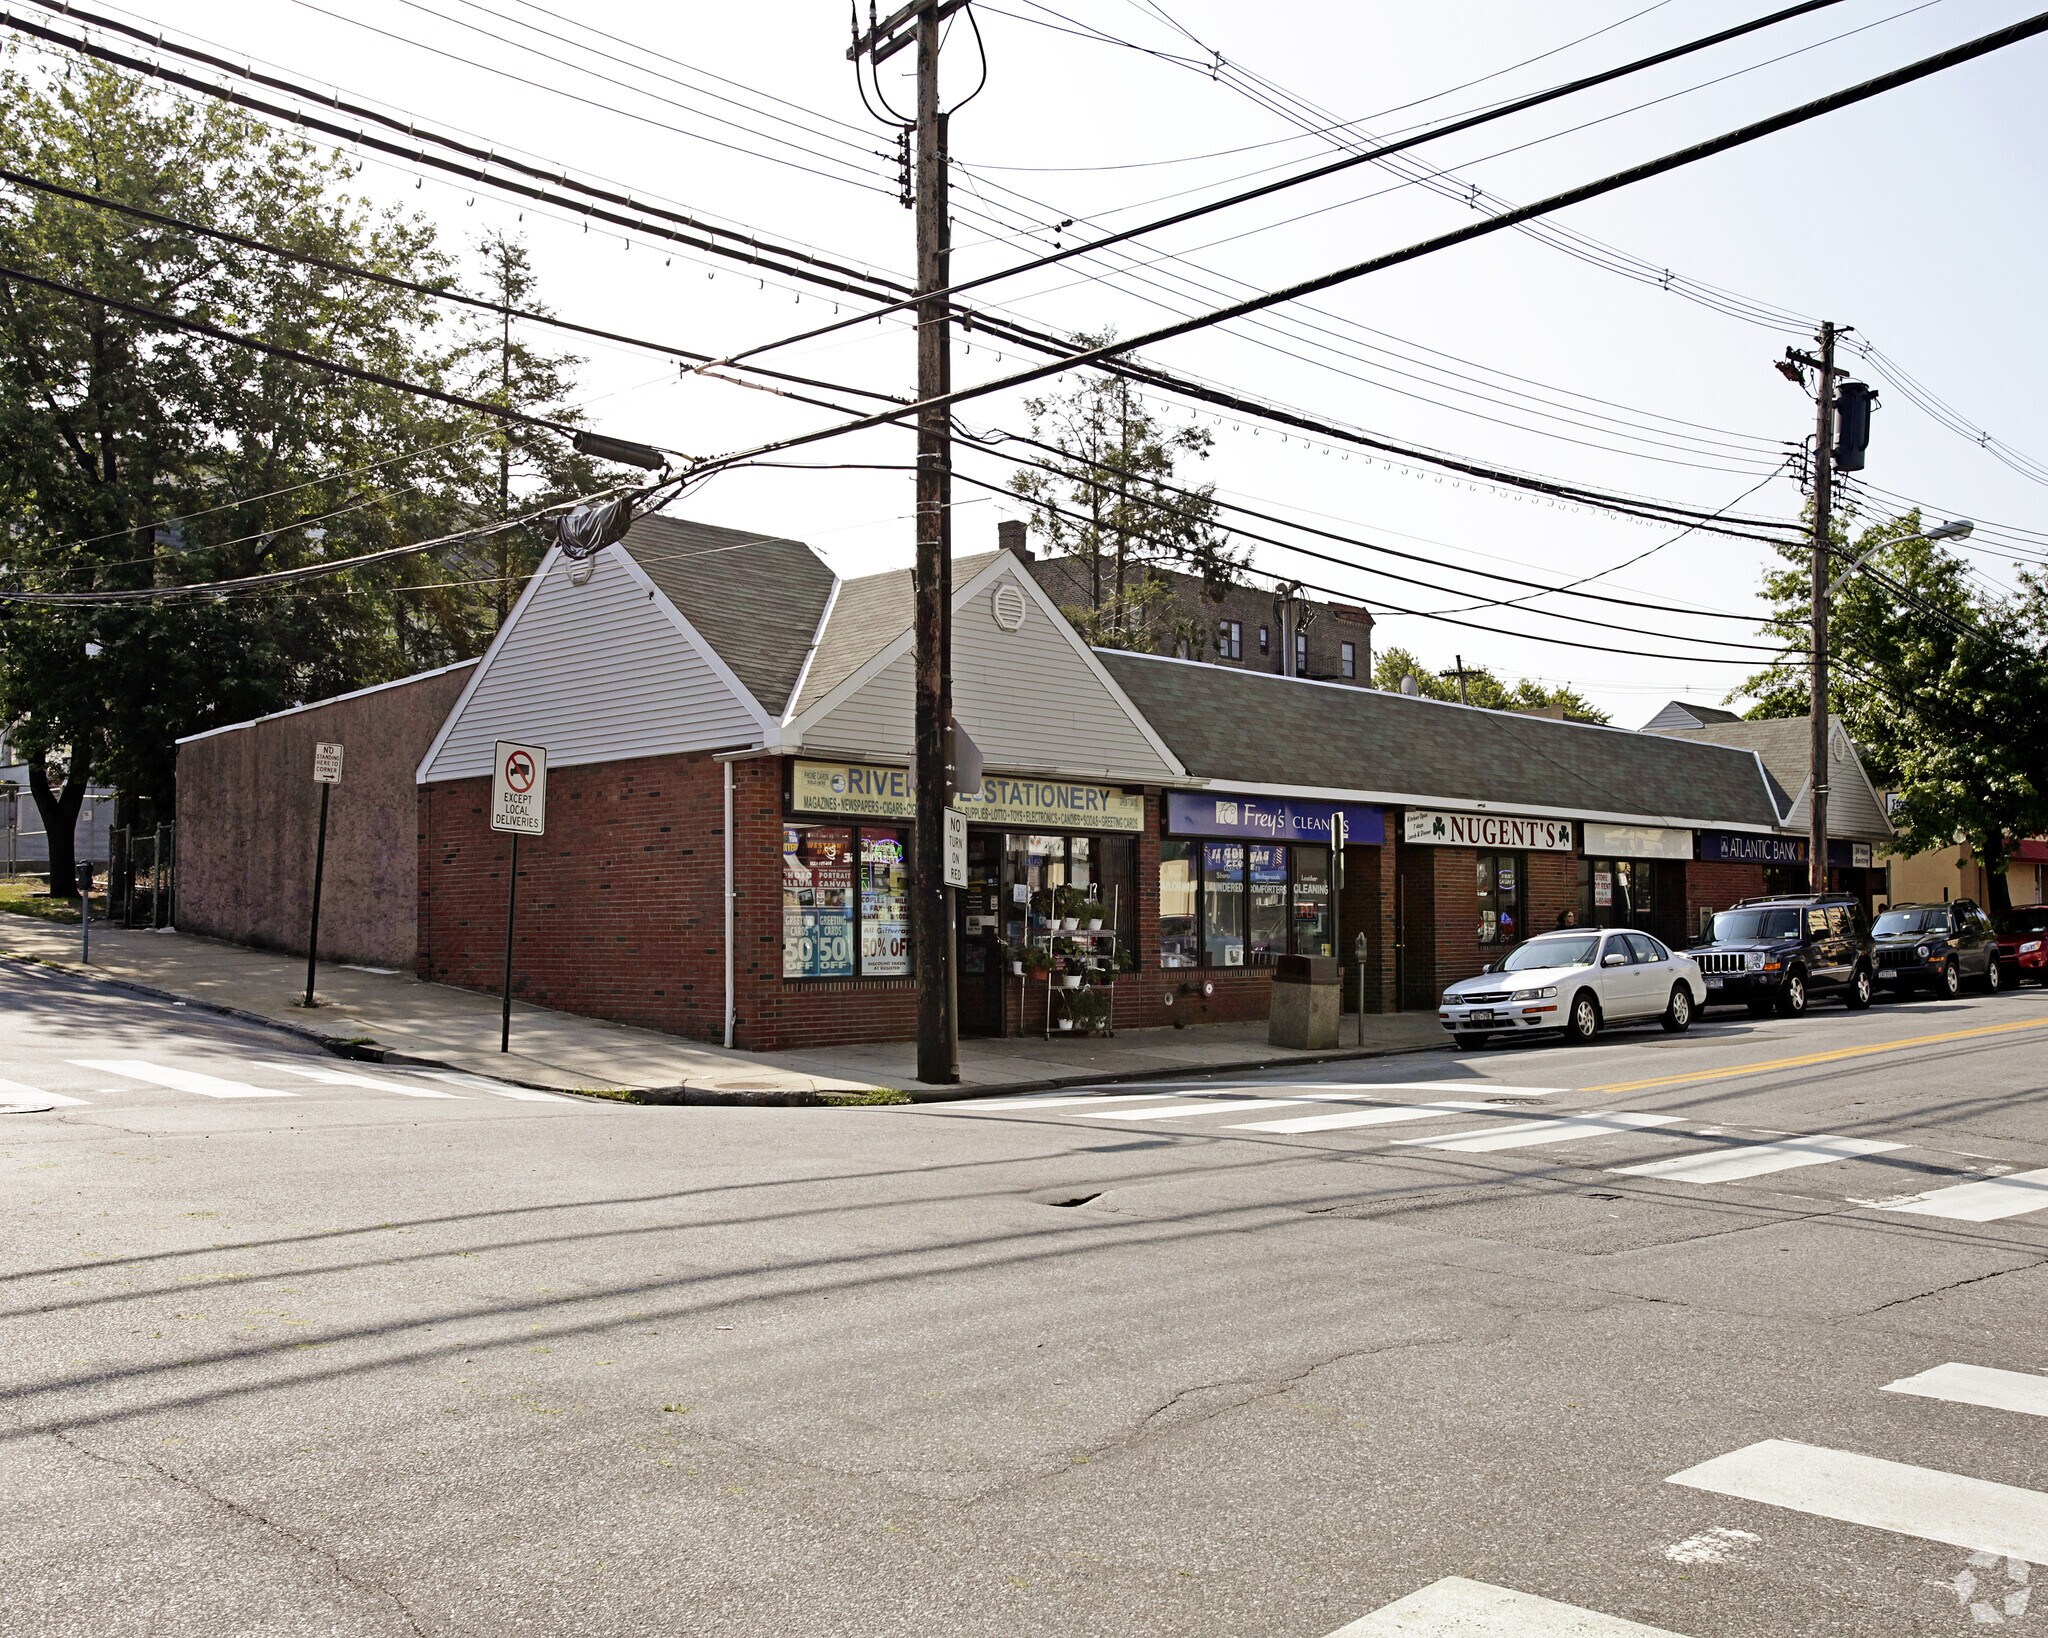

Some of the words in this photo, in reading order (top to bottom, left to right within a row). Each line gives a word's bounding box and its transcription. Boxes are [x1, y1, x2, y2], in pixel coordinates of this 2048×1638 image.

[323, 746, 334, 754] NO
[316, 753, 340, 761] STANDING
[504, 792, 533, 805] EXCEPT
[984, 779, 1111, 812] STATIONERY
[505, 804, 530, 816] LOCAL
[803, 795, 837, 811] MAGAZINES
[840, 799, 879, 814] NEWSPAPERS
[882, 802, 903, 816] CIGARS
[496, 813, 539, 828] DELIVERIES
[965, 806, 990, 820] SUPPLIES
[991, 810, 1007, 822] LOTTO
[1010, 811, 1023, 823] TOYS
[1026, 811, 1058, 825] ELECTRONICS
[1060, 815, 1081, 826] CANDIES
[1083, 816, 1099, 827] SODAS
[1101, 817, 1124, 829] GREETING
[1123, 819, 1139, 830] CARDS
[1244, 803, 1285, 836] Frey's
[1292, 815, 1349, 833] CLEANS
[950, 817, 961, 832] NO
[1450, 816, 1555, 848] NUGENT'S
[949, 835, 963, 849] TURN
[1729, 837, 1771, 860] ATLANTIC
[1773, 841, 1797, 861] BANK
[951, 852, 960, 864] ON
[950, 867, 961, 881] RED
[1301, 874, 1319, 882] Leather
[1204, 882, 1244, 893] LAUNDERED
[1250, 884, 1287, 895] COMFORTERS
[1293, 884, 1329, 895] CLEANING
[785, 915, 815, 926] GREETING
[820, 915, 847, 926] GREETING
[790, 926, 809, 936] CARDS
[824, 926, 843, 936] CARDS
[876, 928, 911, 936] Giftwrap
[862, 938, 887, 957] 50%
[785, 962, 814, 970] OFF
[820, 962, 847, 970] OFF
